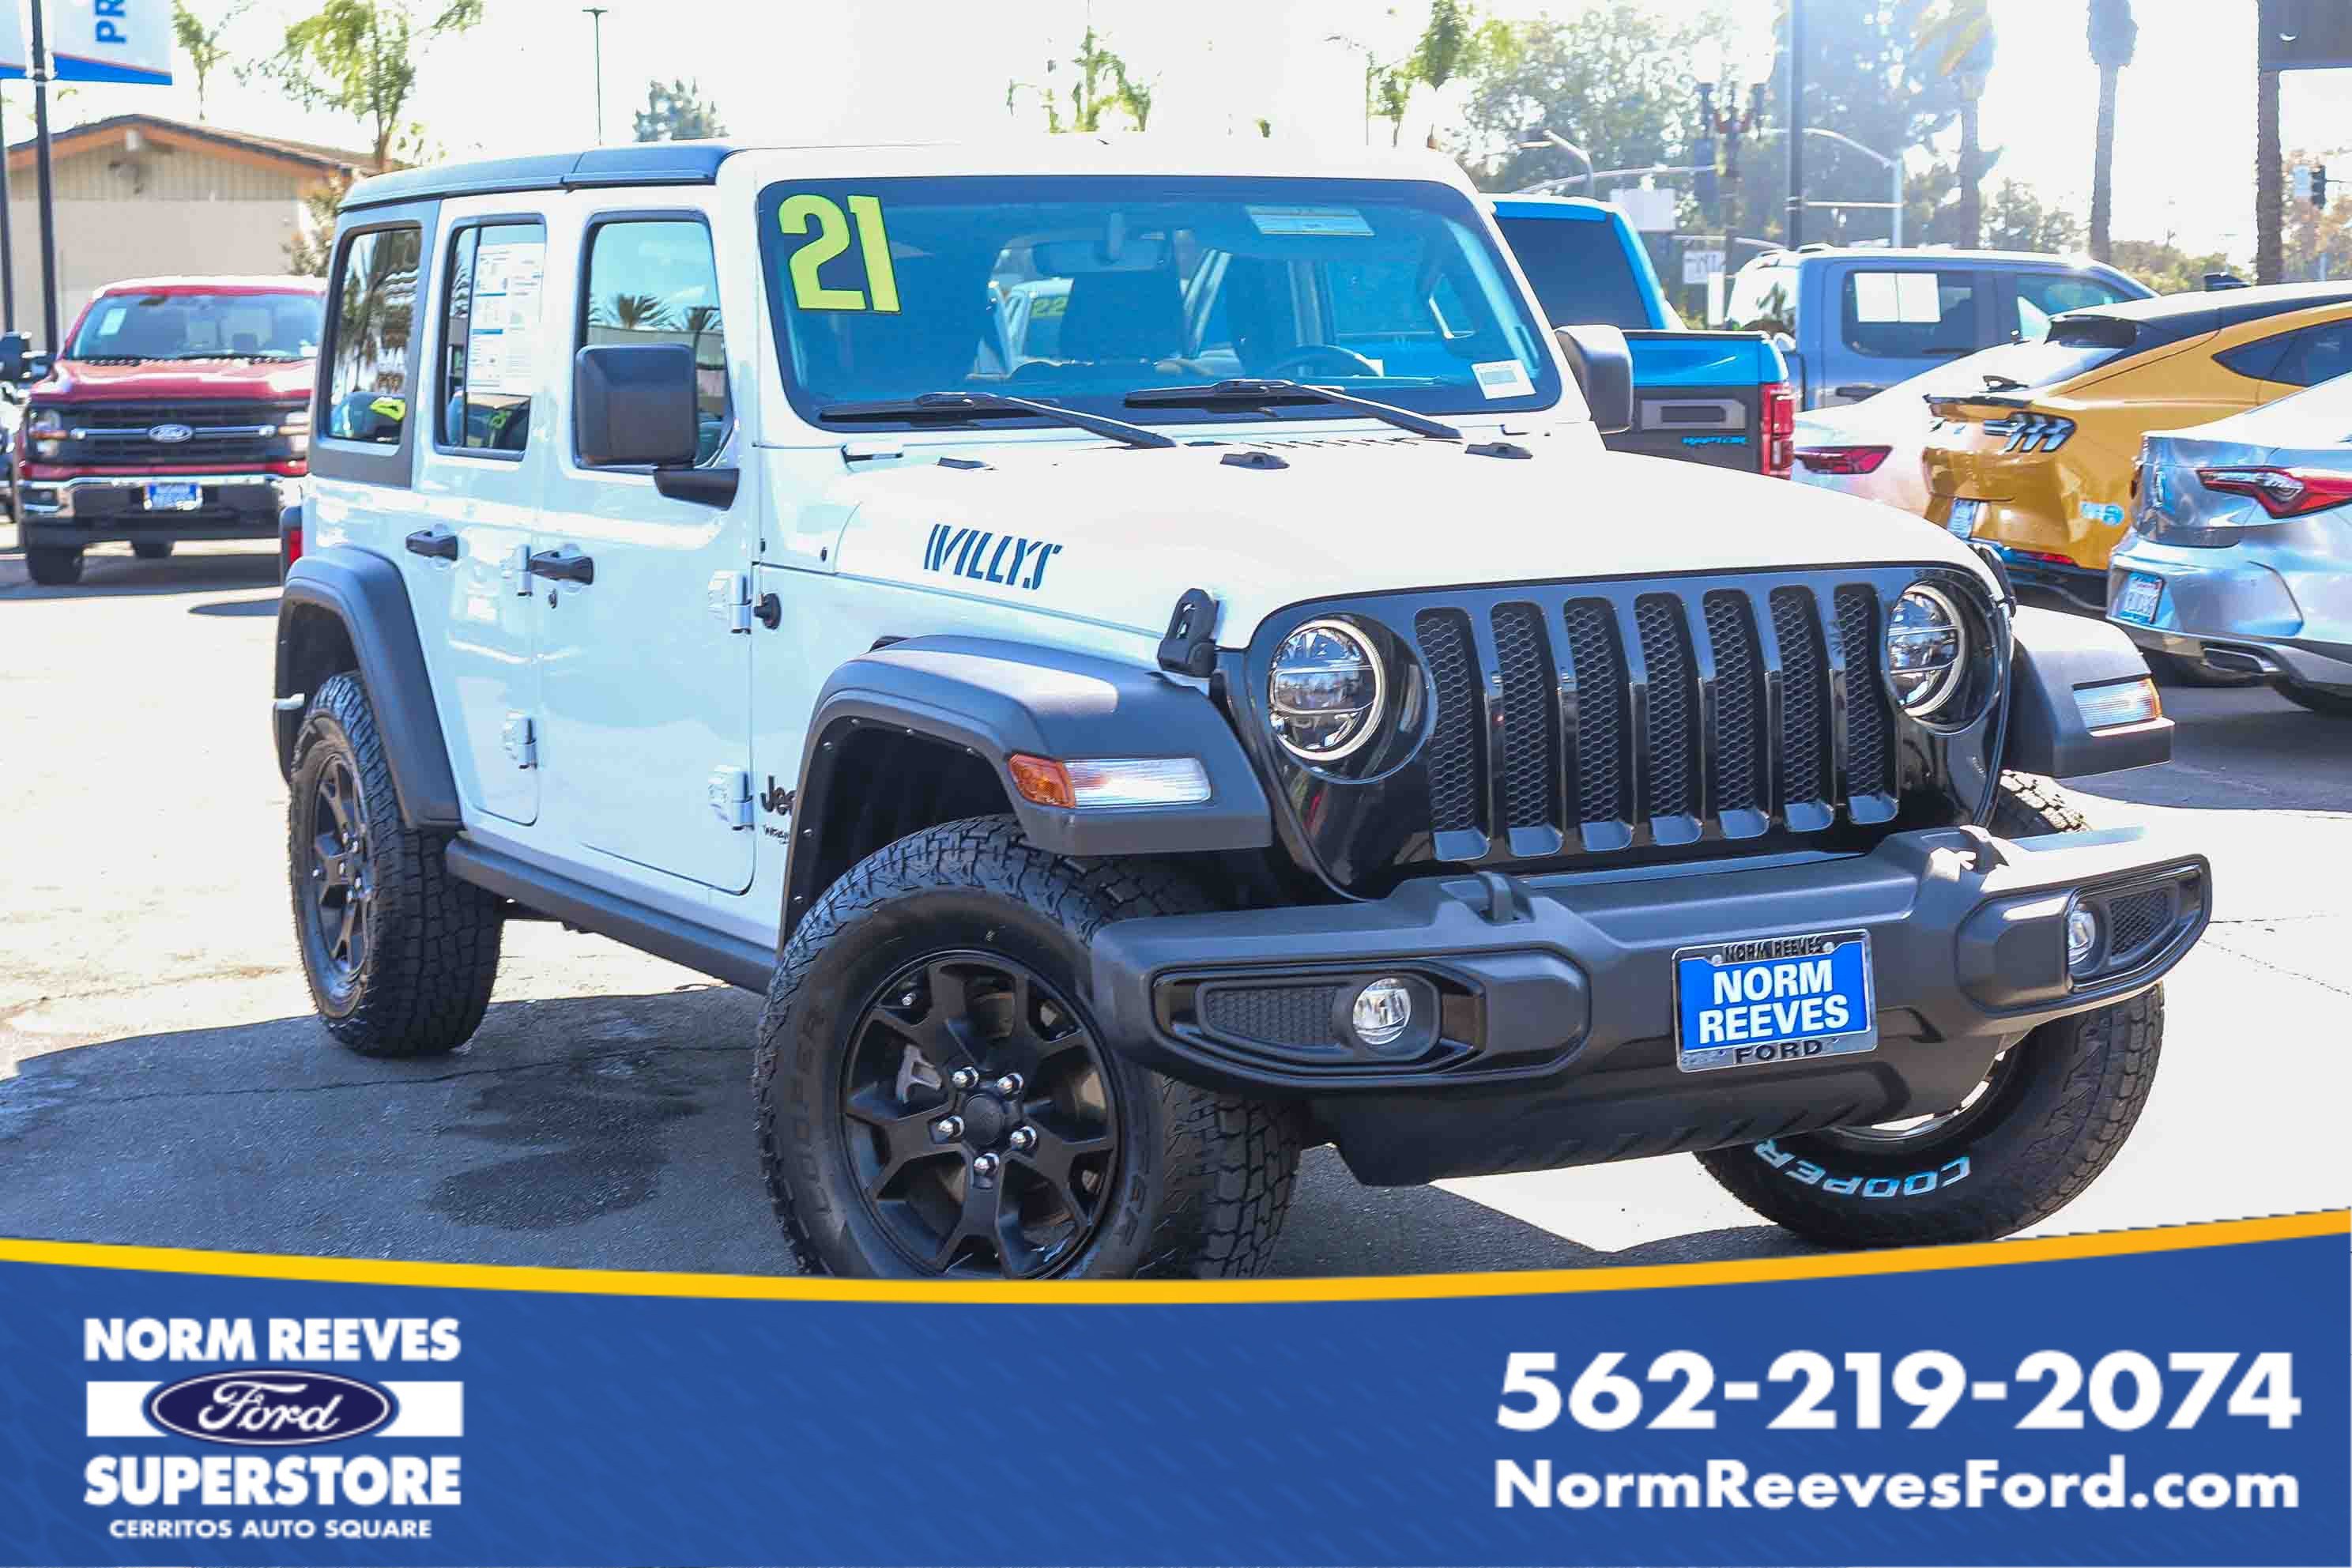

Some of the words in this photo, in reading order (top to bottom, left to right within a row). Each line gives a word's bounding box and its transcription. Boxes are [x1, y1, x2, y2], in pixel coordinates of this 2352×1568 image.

[95, 0, 126, 43] PR
[778, 194, 902, 312] 21
[923, 523, 1063, 590] WILLYS
[1722, 943, 1766, 963] NORM
[1772, 936, 1822, 957] REEVES
[1713, 959, 1834, 1005] NORM
[1698, 993, 1850, 1044] REEVES
[1733, 1039, 1823, 1065] FORD
[1753, 1137, 1971, 1198] COOPER
